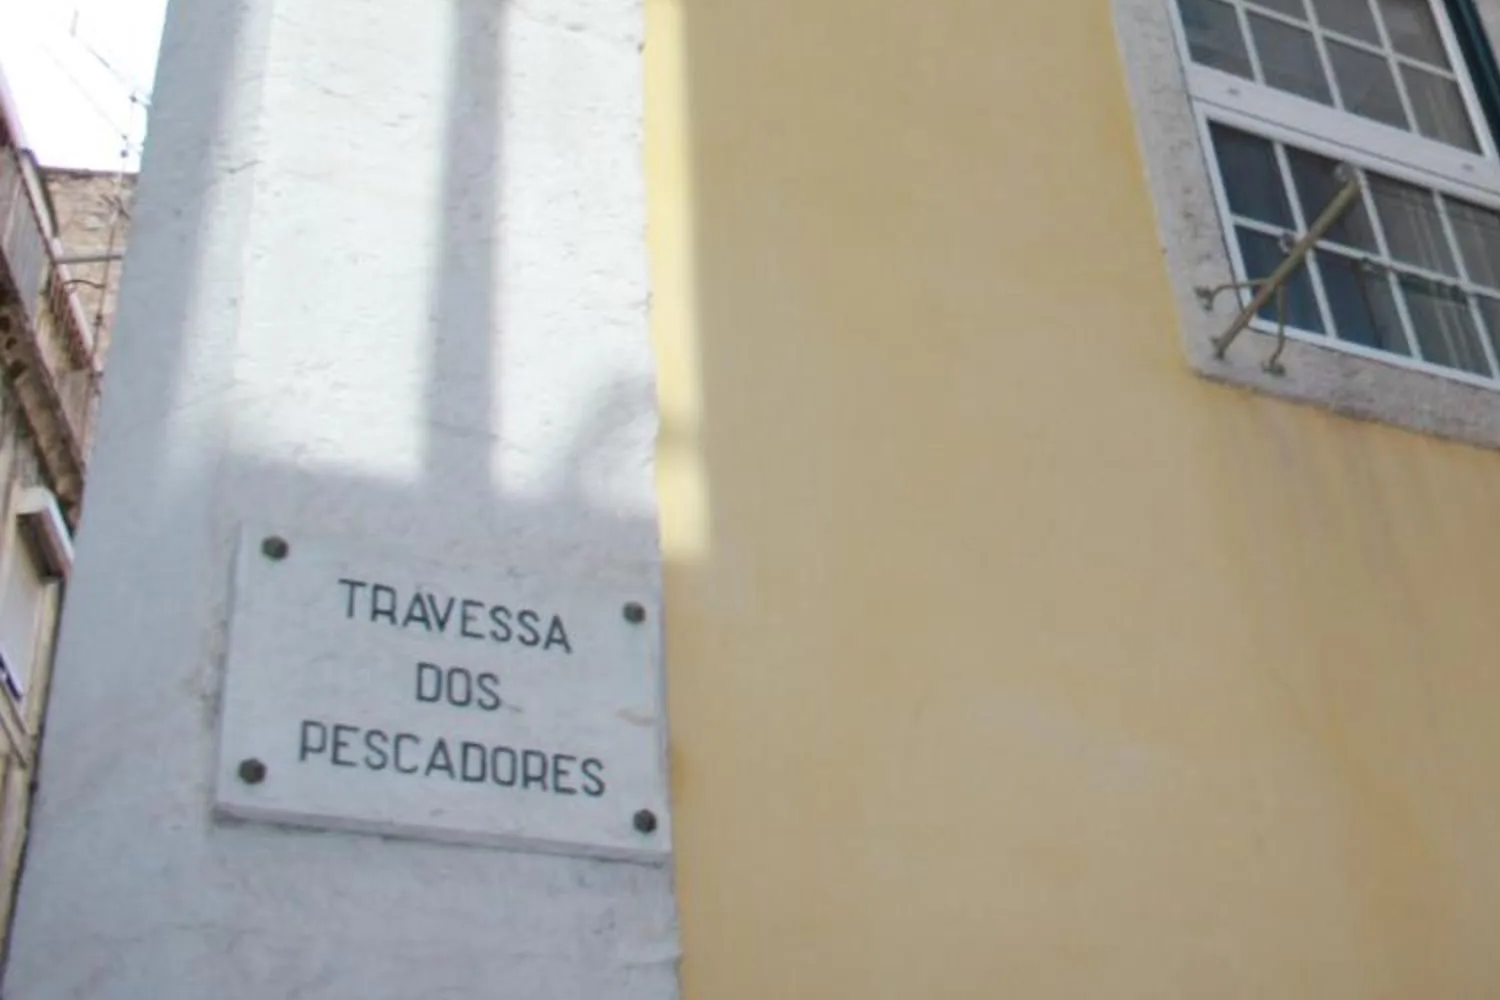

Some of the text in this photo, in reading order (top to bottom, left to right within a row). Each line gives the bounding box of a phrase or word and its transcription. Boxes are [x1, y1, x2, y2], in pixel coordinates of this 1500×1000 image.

[339, 578, 572, 654] TRAVESSA
[415, 662, 502, 711] DOS
[299, 720, 606, 797] PESCADORES
